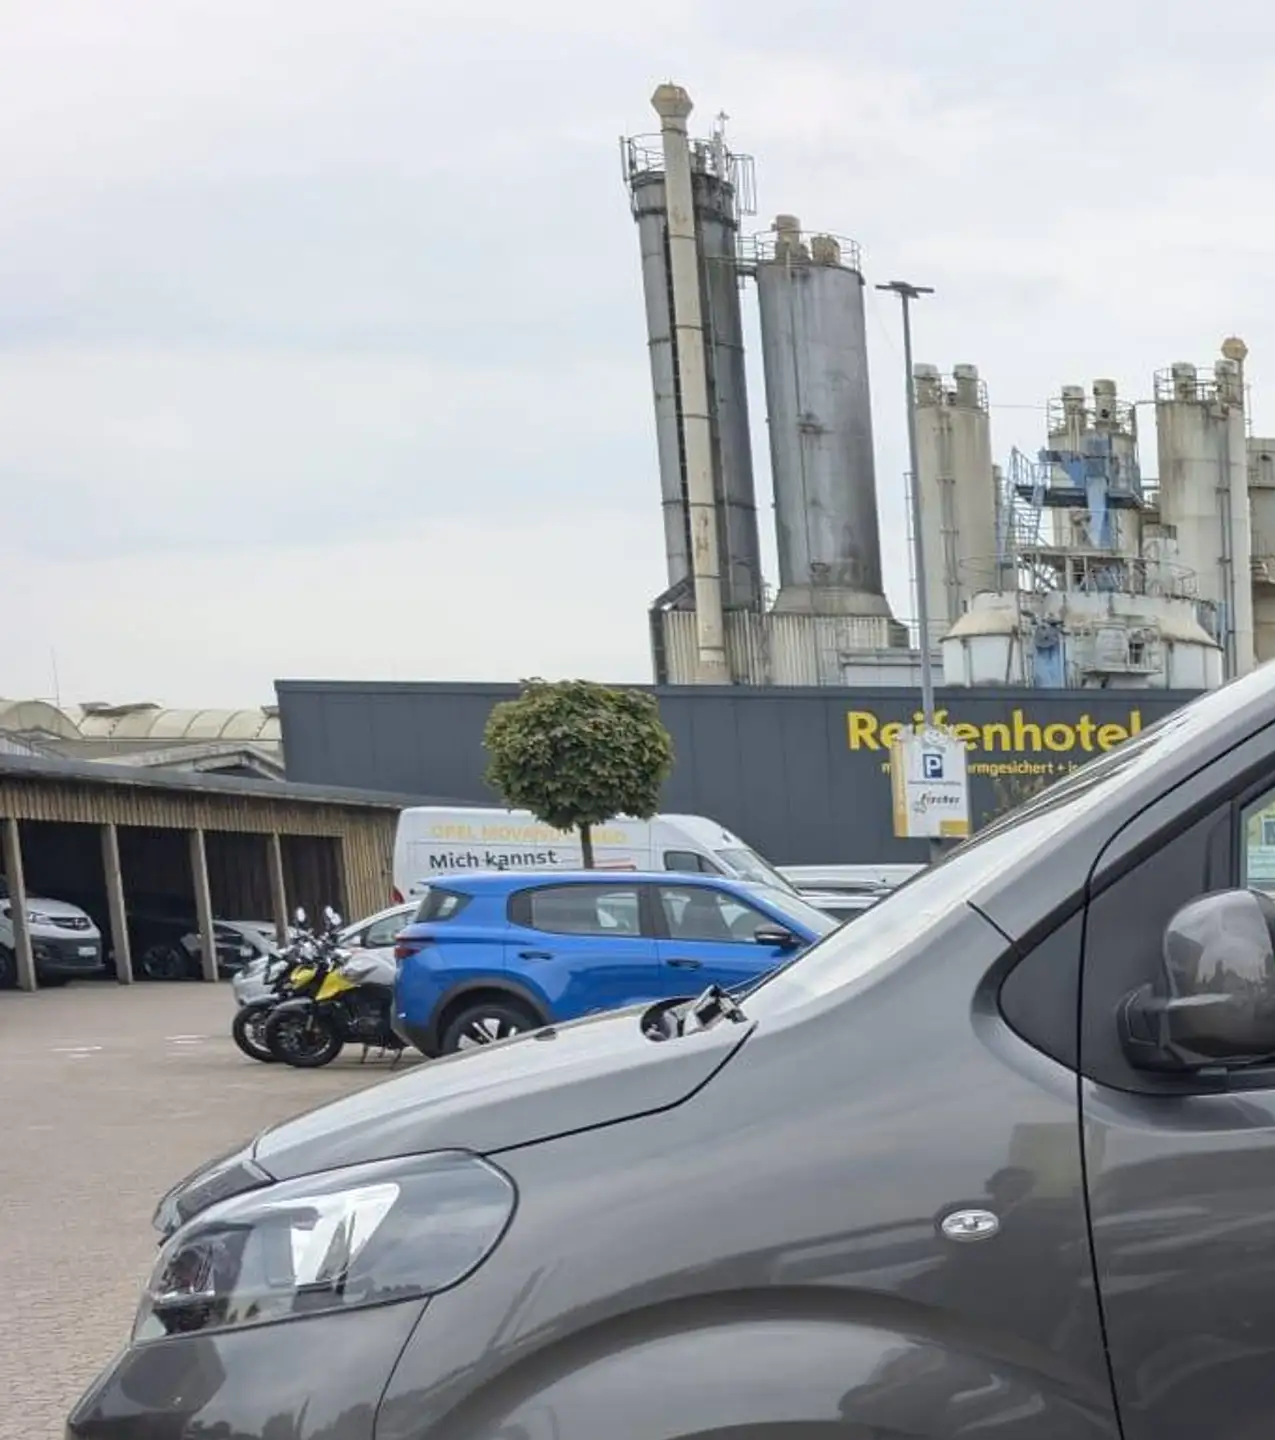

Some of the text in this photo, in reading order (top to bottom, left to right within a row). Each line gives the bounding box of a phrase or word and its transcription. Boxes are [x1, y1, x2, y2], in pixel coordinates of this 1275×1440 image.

[925, 756, 941, 778] P
[429, 849, 557, 869] Mich kannst
